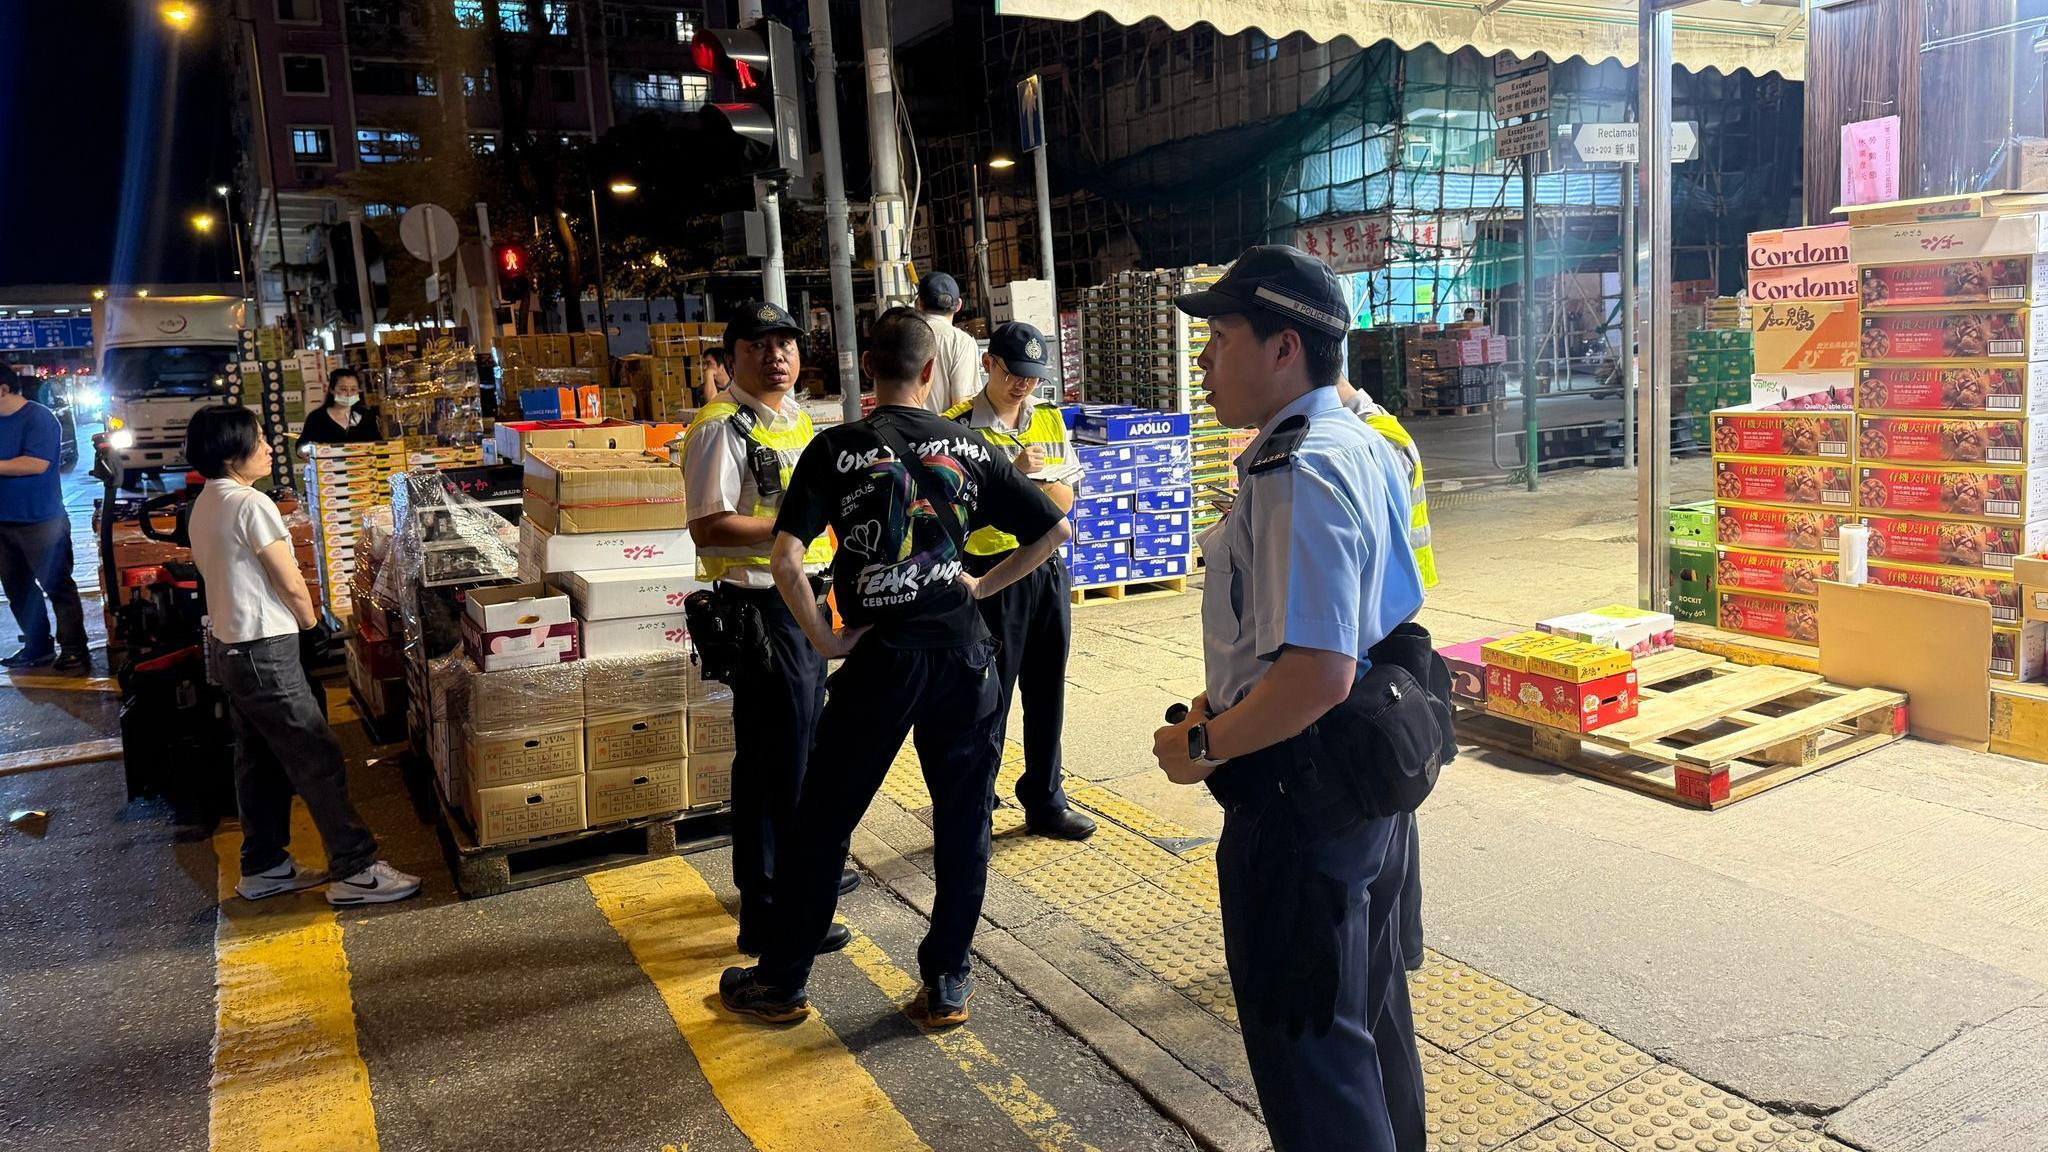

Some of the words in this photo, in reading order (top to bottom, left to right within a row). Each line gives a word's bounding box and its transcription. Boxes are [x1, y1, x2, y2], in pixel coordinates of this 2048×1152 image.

[1511, 80, 1532, 91] Except
[1497, 91, 1520, 103] General
[1520, 84, 1547, 98] Holidays
[1507, 126, 1526, 136] Except
[1598, 128, 1639, 139] Reclamati
[1751, 243, 1848, 267] Cordom
[1300, 305, 1327, 321] POLICE
[1804, 403, 1825, 411] Quality
[1129, 421, 1171, 436] APOLLO
[623, 544, 664, 560] マンゴー
[666, 591, 692, 607] マン
[1679, 595, 1702, 605] ROCKIT
[1694, 608, 1707, 617] day
